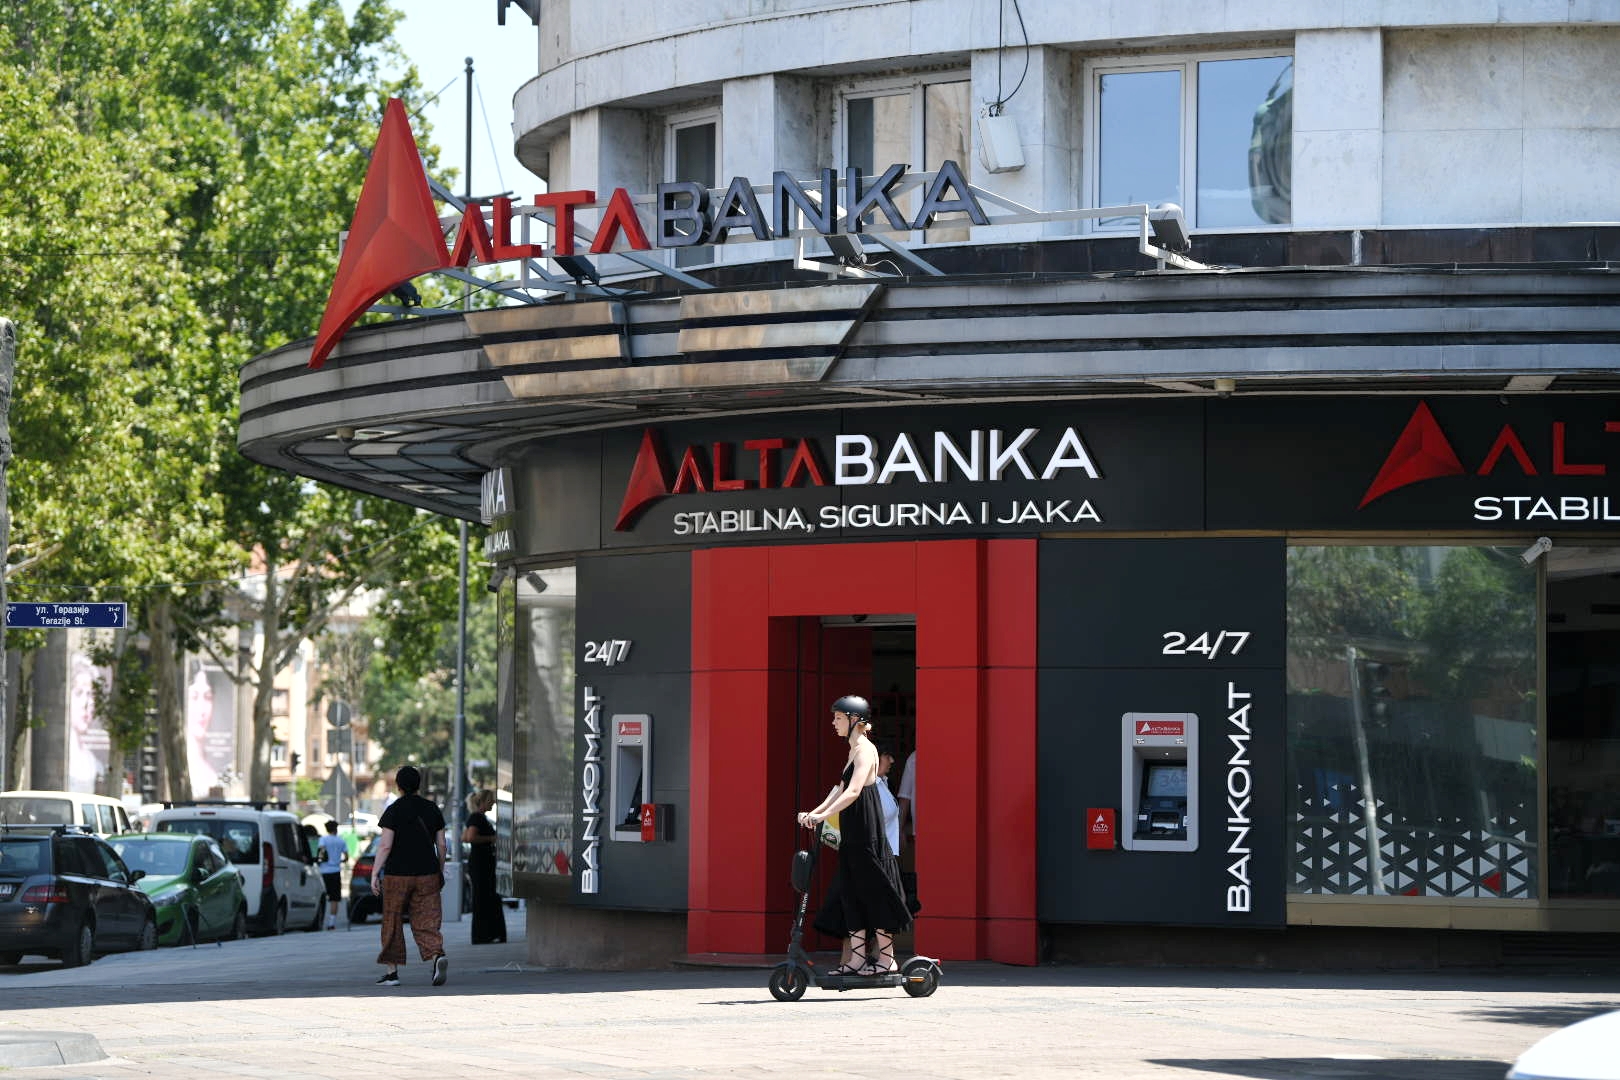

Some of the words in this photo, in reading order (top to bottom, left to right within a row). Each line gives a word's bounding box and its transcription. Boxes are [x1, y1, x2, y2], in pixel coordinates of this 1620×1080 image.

[673, 506, 815, 535] STABILNA,
[819, 501, 974, 529] SIGURNA
[981, 501, 990, 525] I
[997, 499, 1104, 525] JAKA
[35, 605, 49, 615] ул.
[53, 604, 90, 616] Теразије
[41, 616, 71, 626] Terazije
[74, 616, 86, 625] St.
[584, 640, 632, 666] 24/7
[1162, 630, 1251, 660] 24/7
[581, 686, 602, 894] BANKOMAT
[1227, 681, 1252, 913] BANKOMAT
